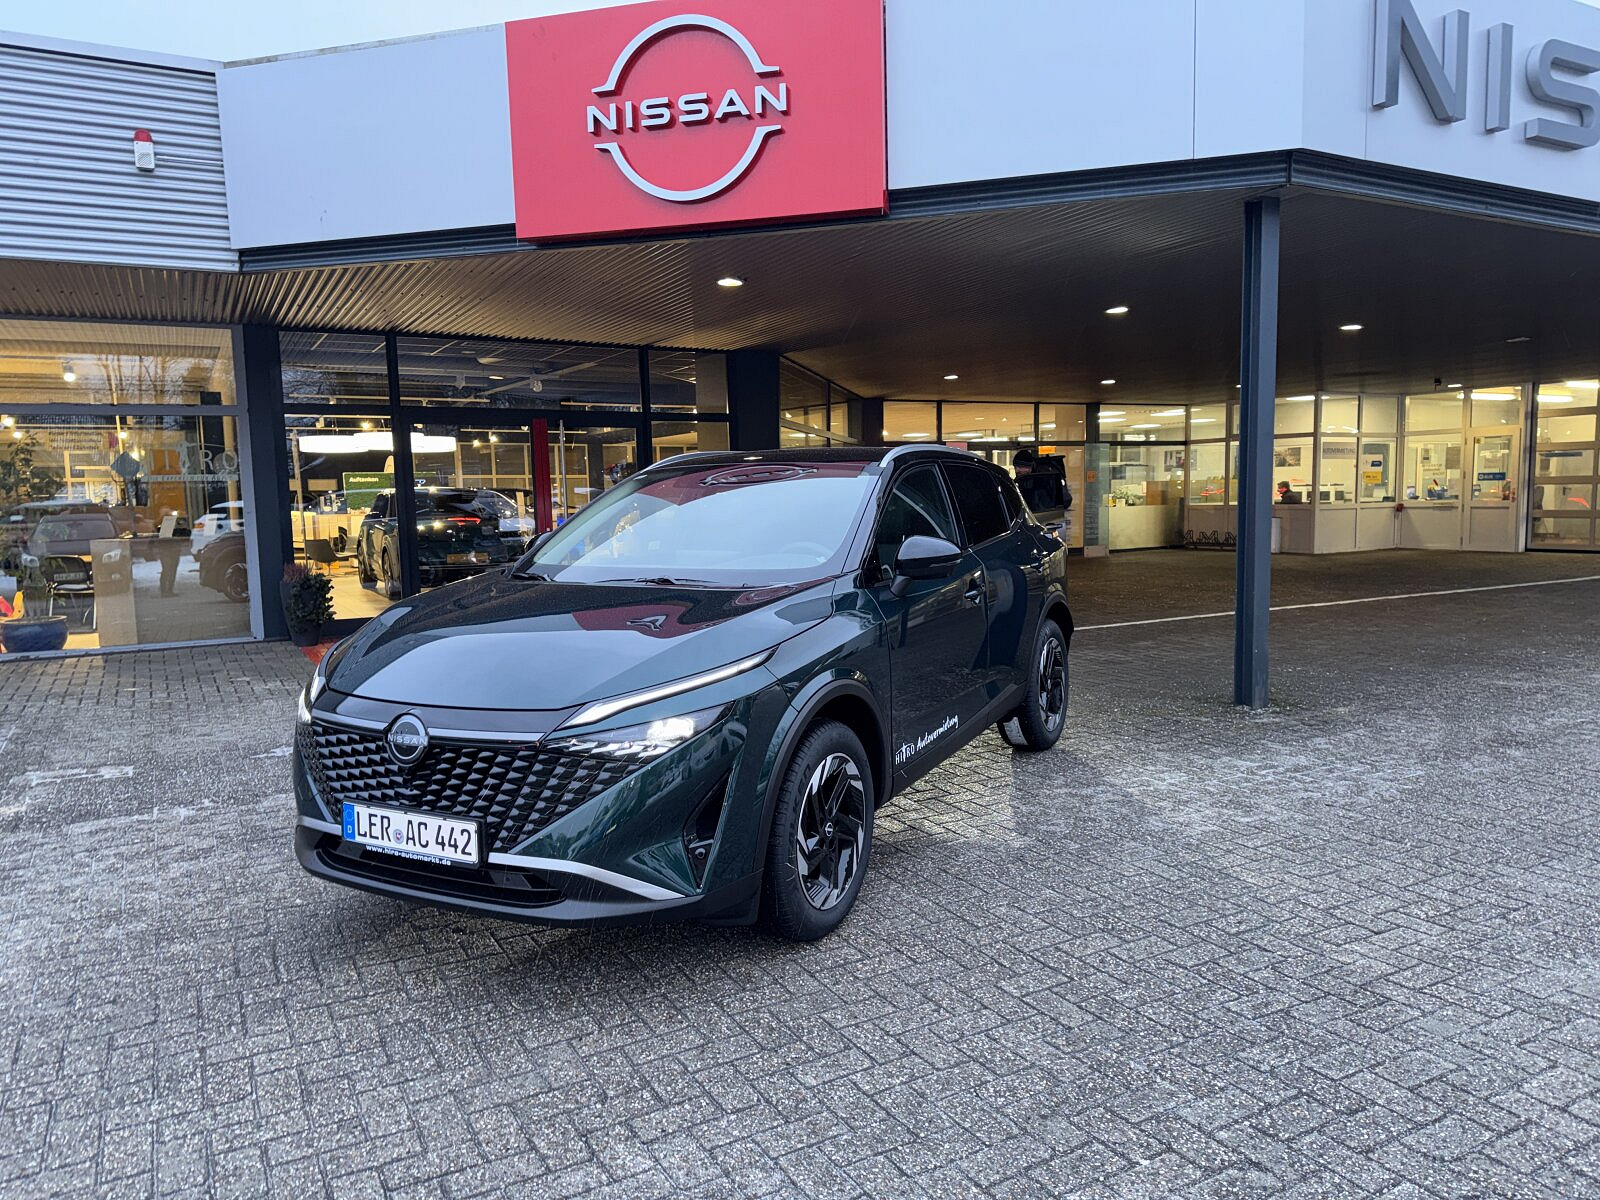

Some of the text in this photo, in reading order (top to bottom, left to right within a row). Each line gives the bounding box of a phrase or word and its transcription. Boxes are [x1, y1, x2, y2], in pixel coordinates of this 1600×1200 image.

[586, 82, 788, 134] NISSAN
[387, 733, 428, 746] NISSAN
[347, 811, 472, 856] D LER AC 442
[365, 844, 452, 867] www.hiro-automarkt.de
